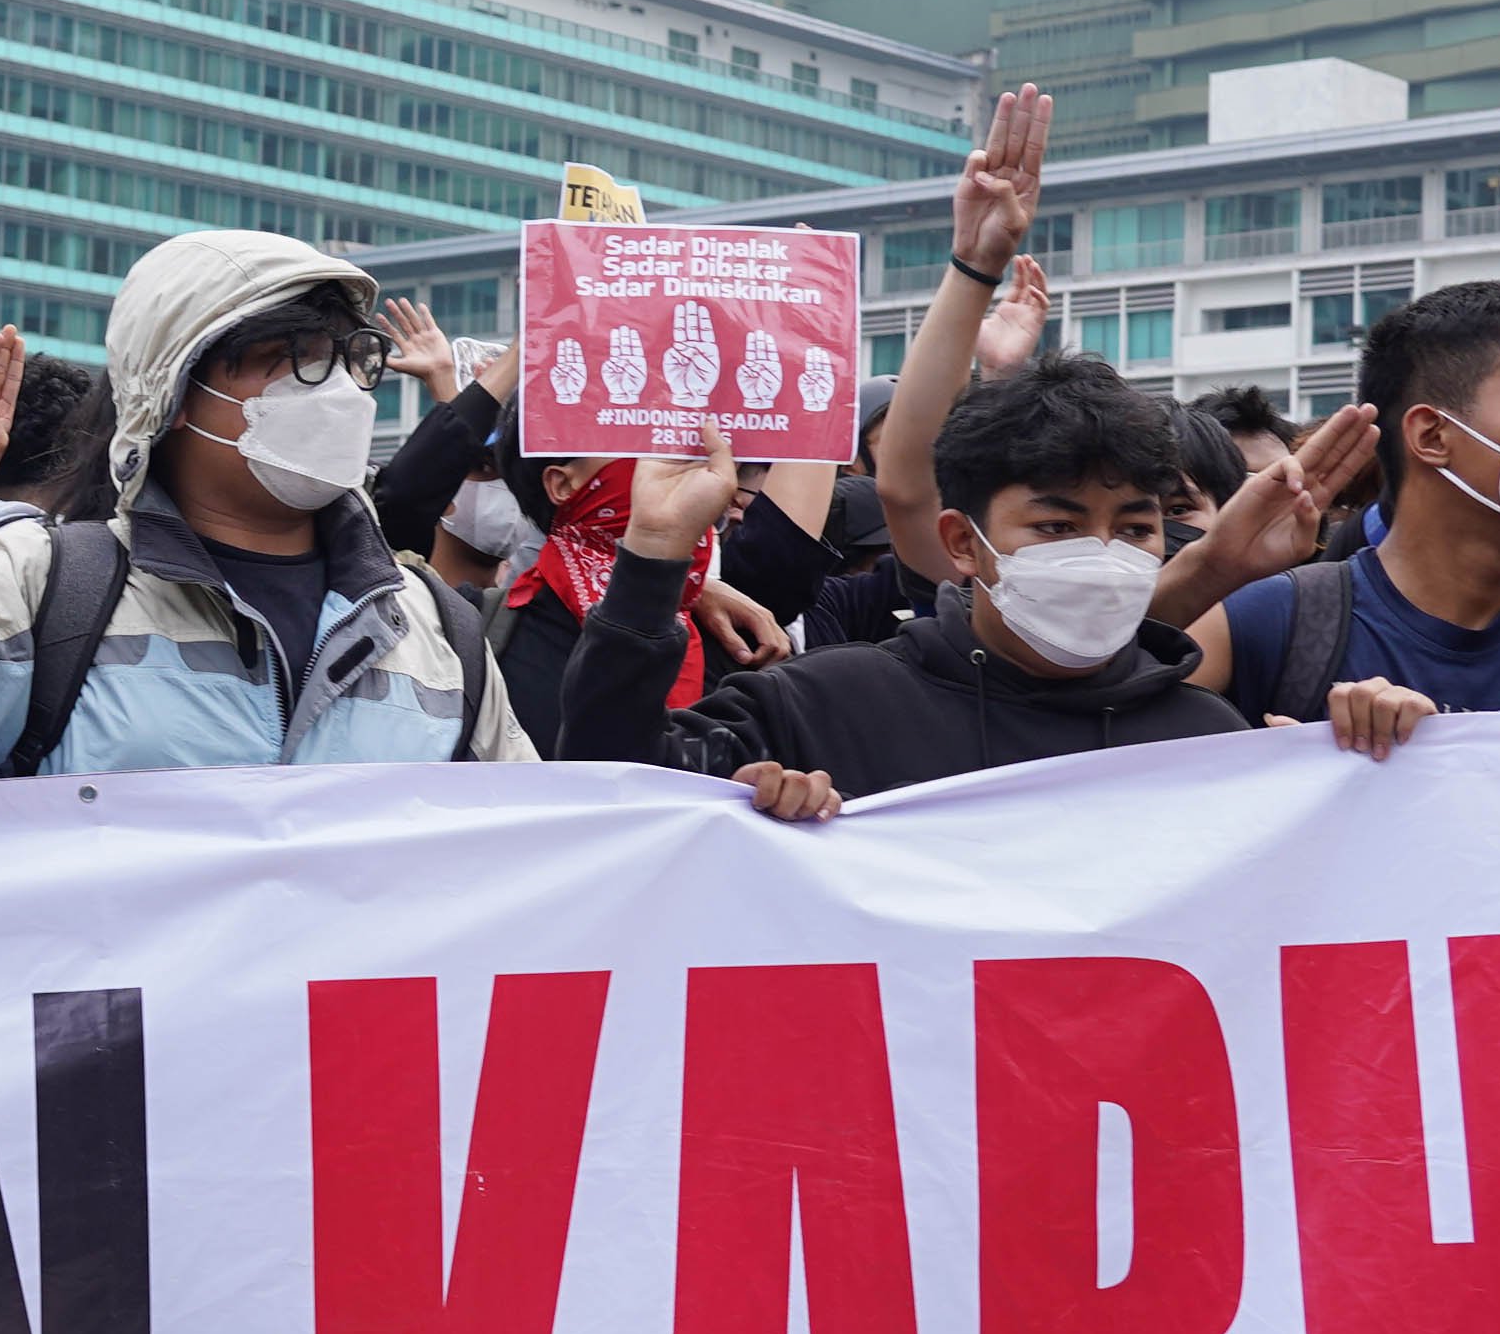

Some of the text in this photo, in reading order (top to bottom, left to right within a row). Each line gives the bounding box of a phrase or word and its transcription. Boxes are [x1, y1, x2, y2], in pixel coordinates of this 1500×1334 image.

[605, 235, 789, 262] Sadar Dipalak
[603, 257, 793, 281] Sadar Dibakar
[575, 276, 823, 306] Sadar Dimiskinkan
